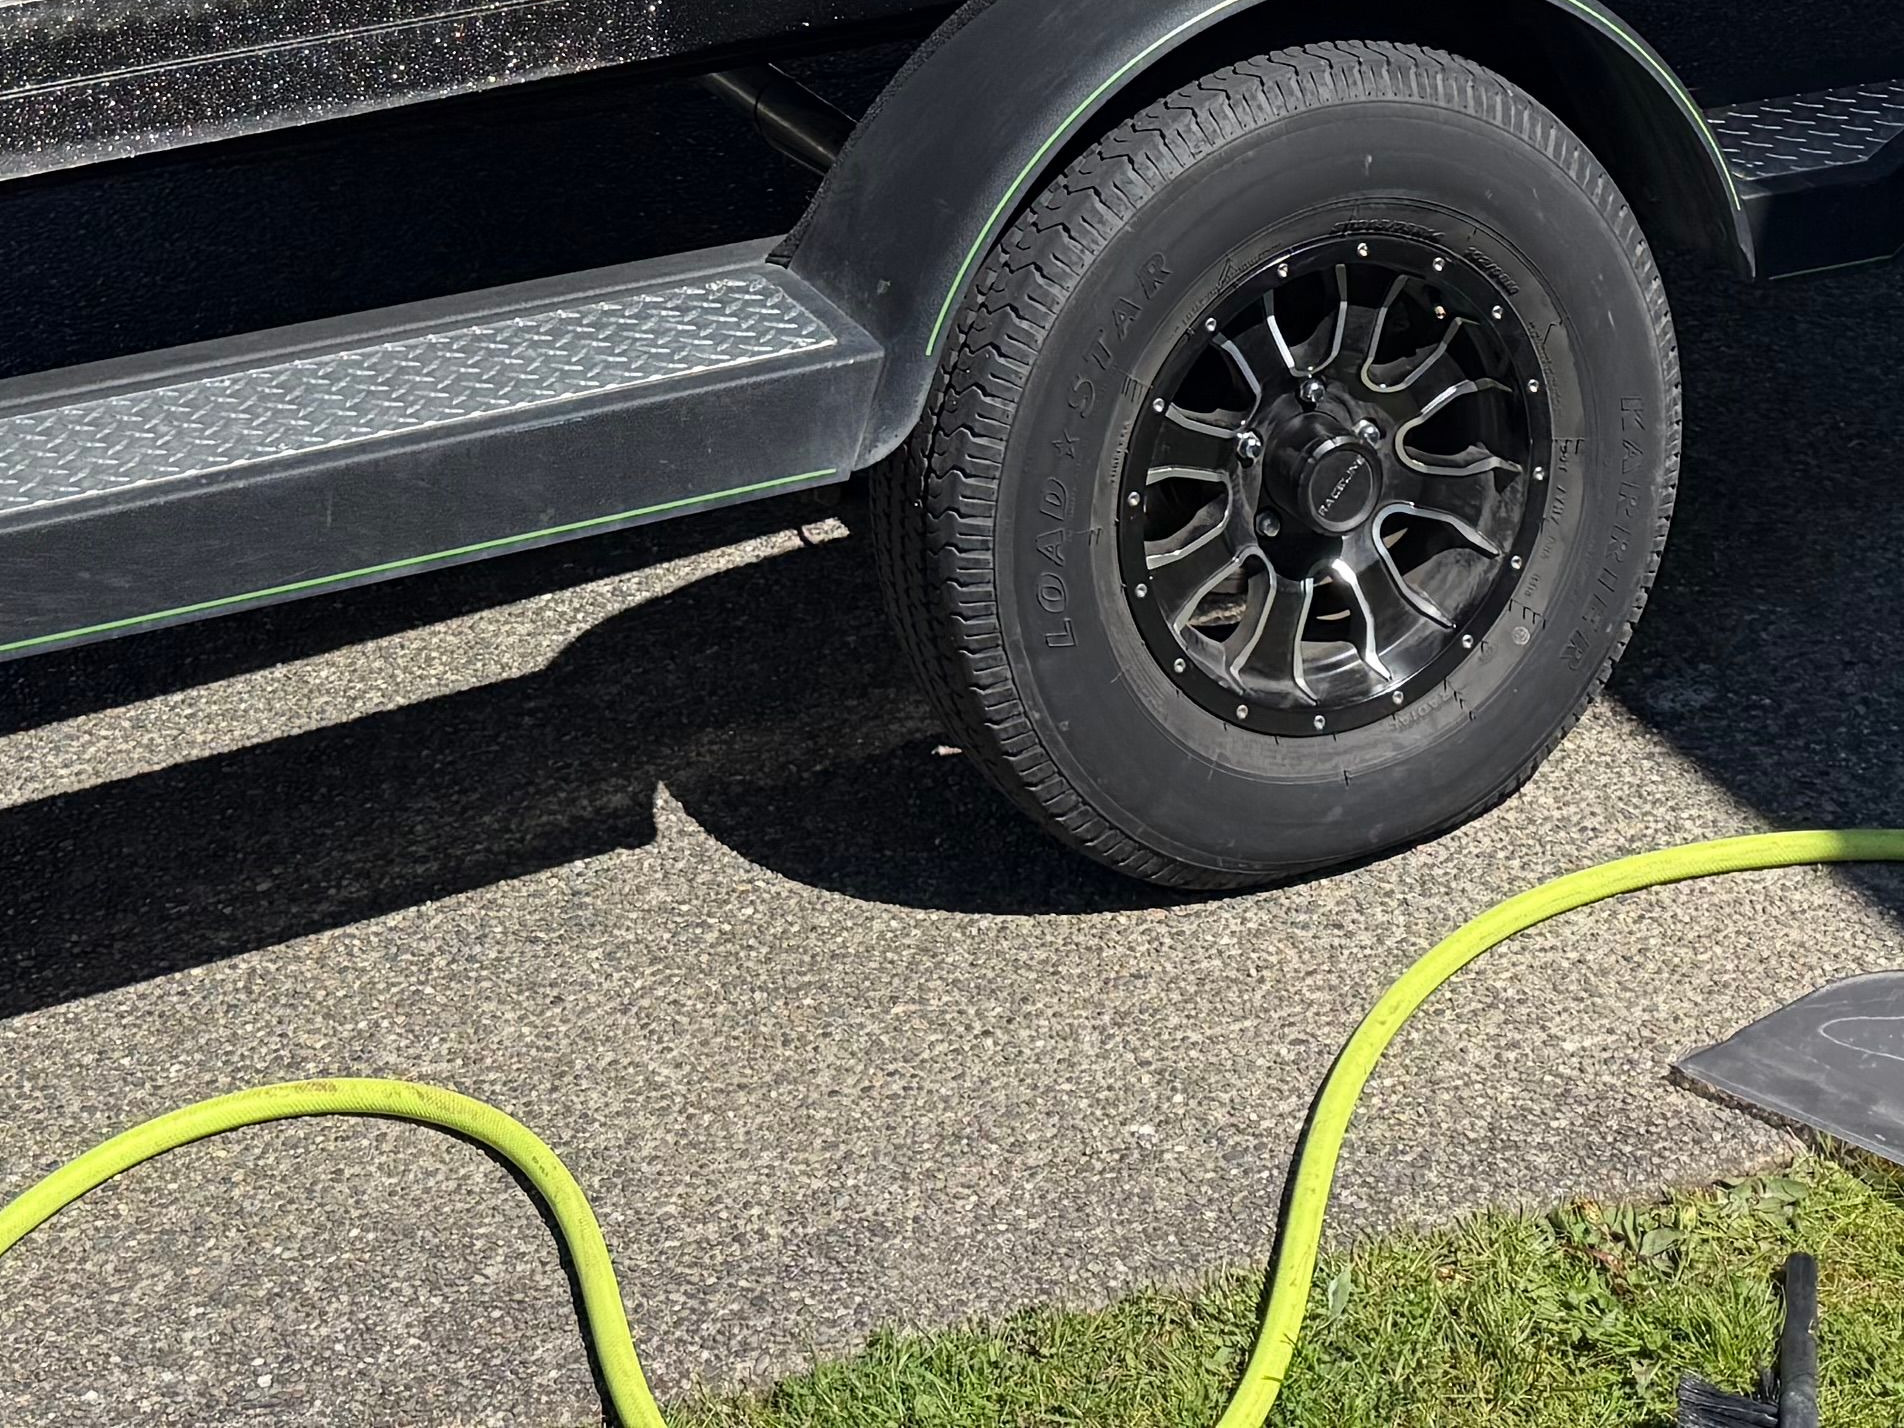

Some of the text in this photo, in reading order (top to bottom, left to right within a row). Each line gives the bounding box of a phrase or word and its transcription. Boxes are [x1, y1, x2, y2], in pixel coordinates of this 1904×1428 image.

[1034, 251, 1174, 649] LOAD STAR
[1318, 454, 1366, 517] RACELINE
[1560, 397, 1647, 672] KARRIER
